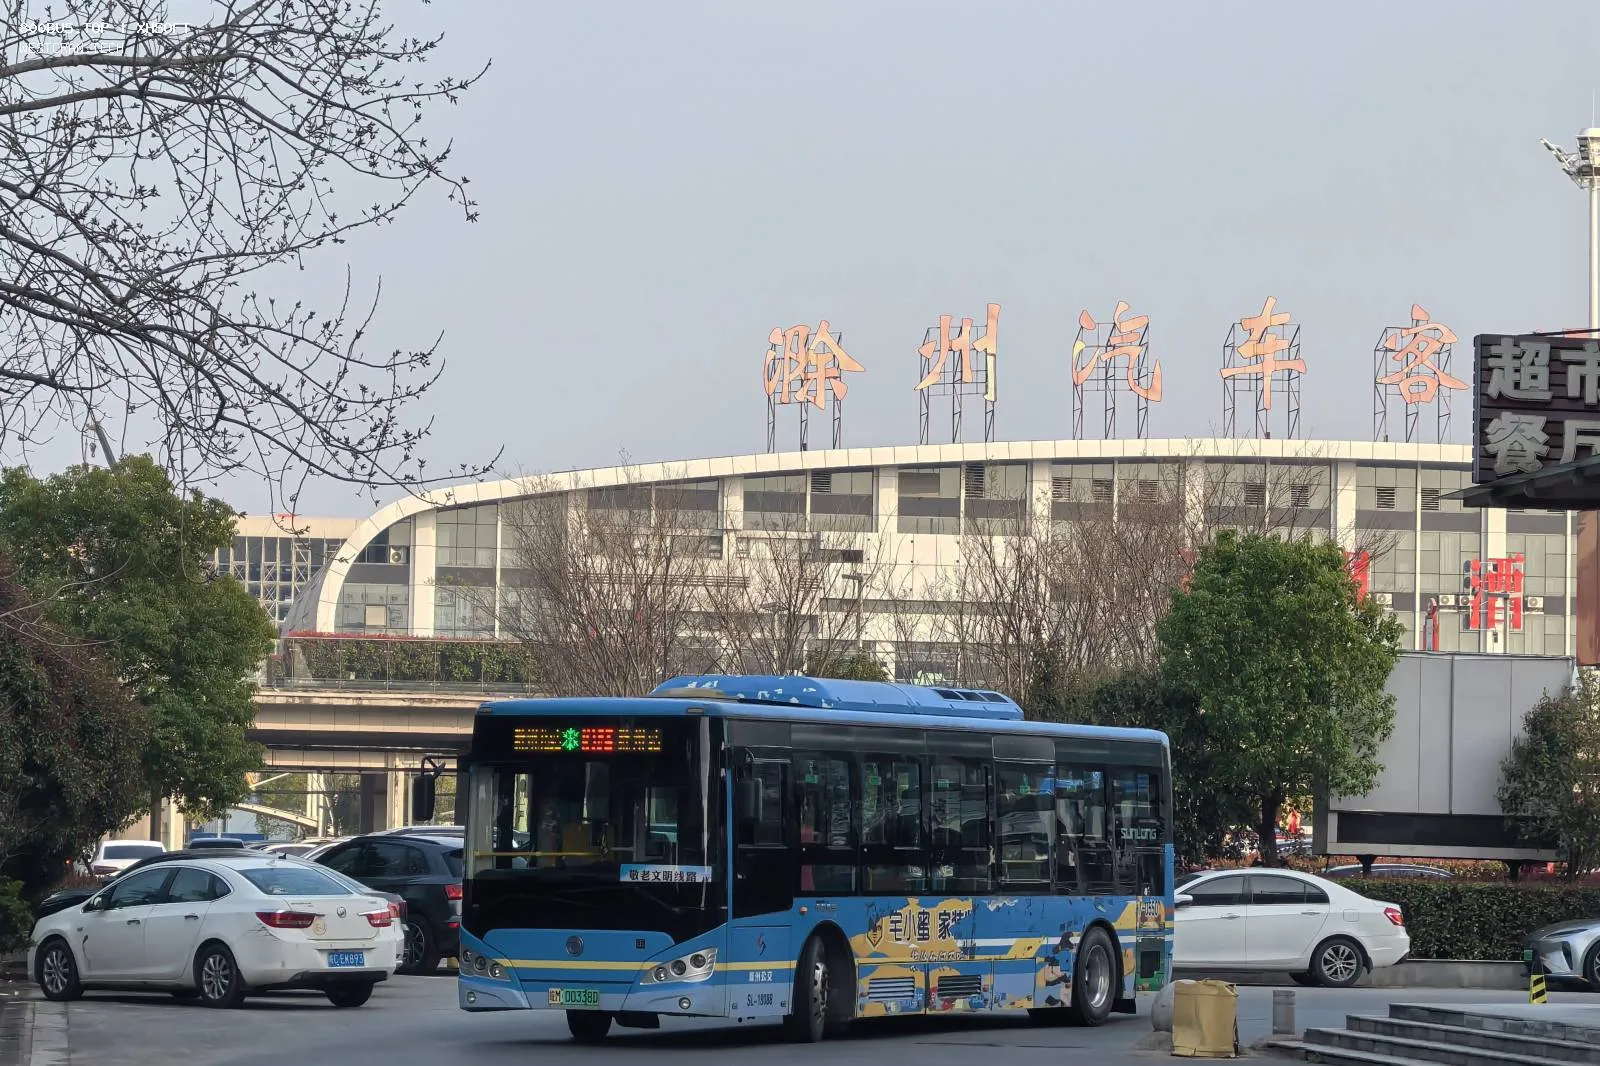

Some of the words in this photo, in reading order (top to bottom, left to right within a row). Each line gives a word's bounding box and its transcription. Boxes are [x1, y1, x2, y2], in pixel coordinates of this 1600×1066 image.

[1487, 337, 1600, 405] 超市
[629, 868, 697, 882] 敬老文明线路
